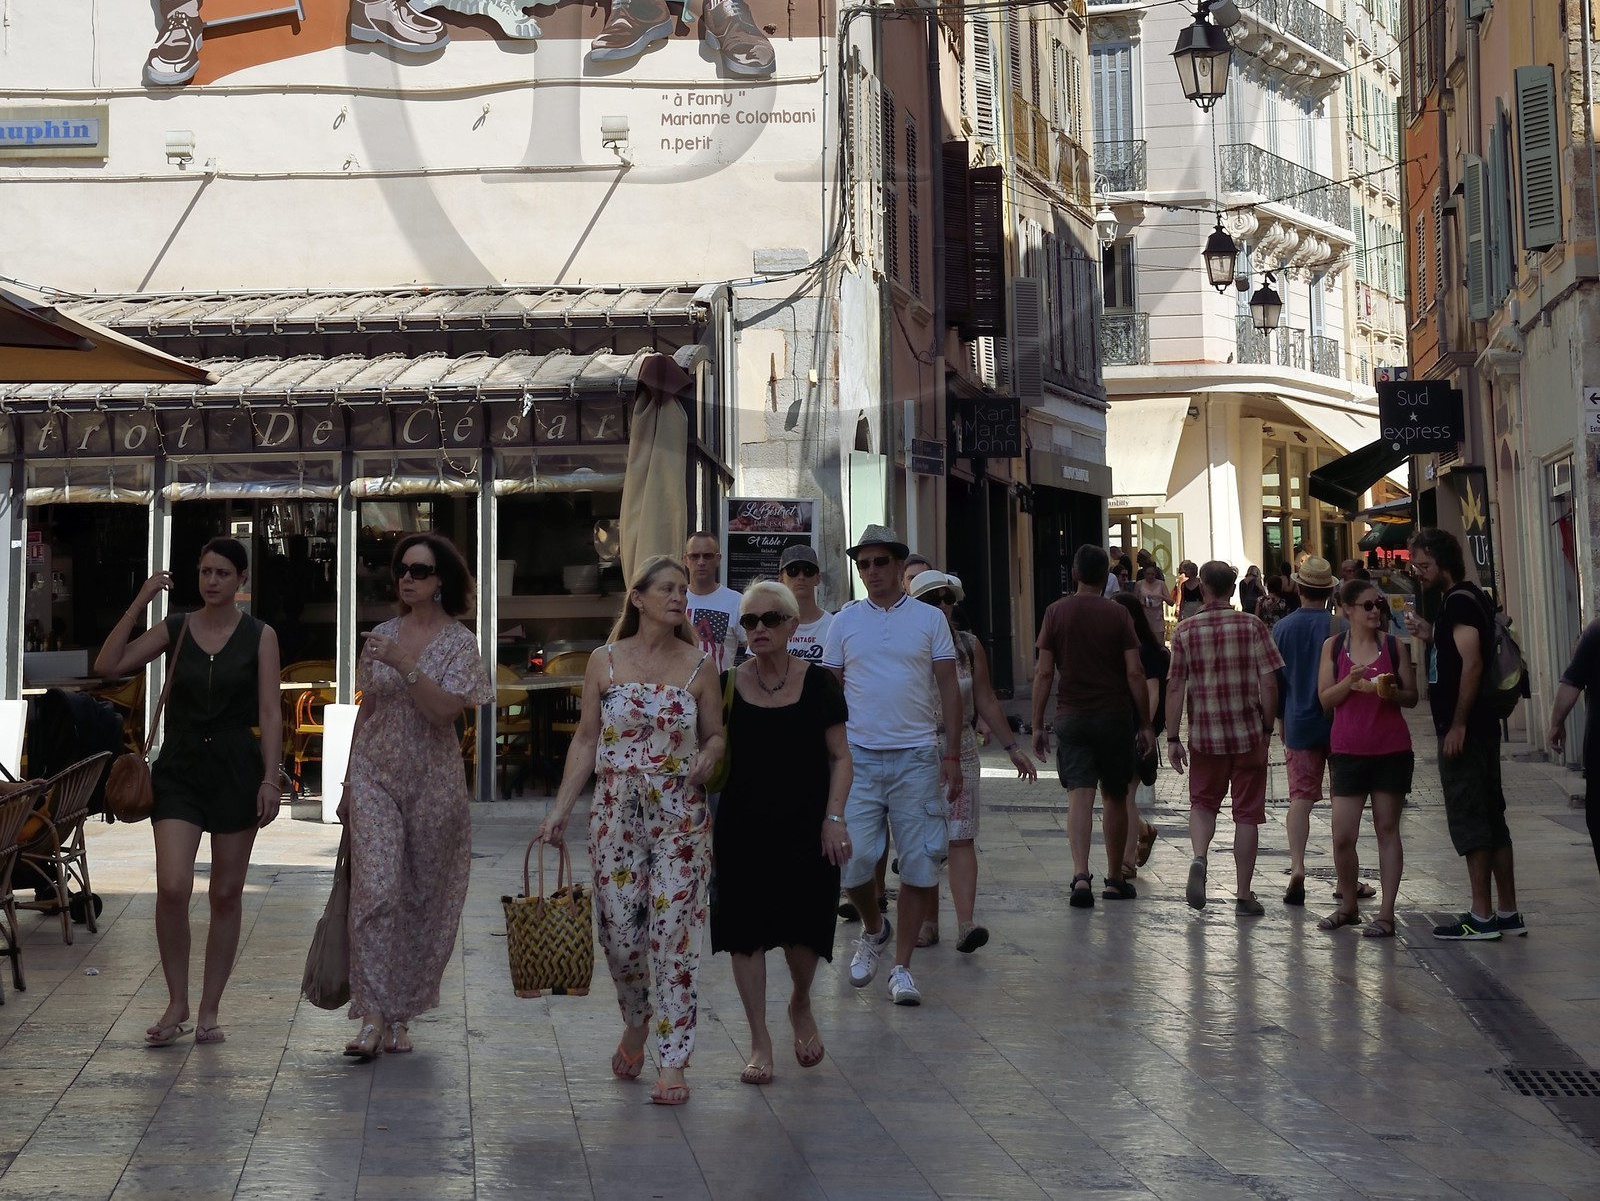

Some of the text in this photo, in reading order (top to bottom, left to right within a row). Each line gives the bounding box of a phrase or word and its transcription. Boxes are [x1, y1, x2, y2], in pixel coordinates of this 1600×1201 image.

[673, 92, 683, 107] à
[687, 92, 733, 108] Fanny
[660, 108, 816, 127] Marianne Colombani
[660, 135, 713, 154] n.petit
[1397, 385, 1429, 406] Sud
[974, 404, 1017, 422] Karl
[0, 406, 616, 451] trot De César
[965, 420, 1017, 437] Marc
[1383, 425, 1451, 445] express
[967, 436, 1017, 452] John
[742, 501, 798, 520] Le Bistrot
